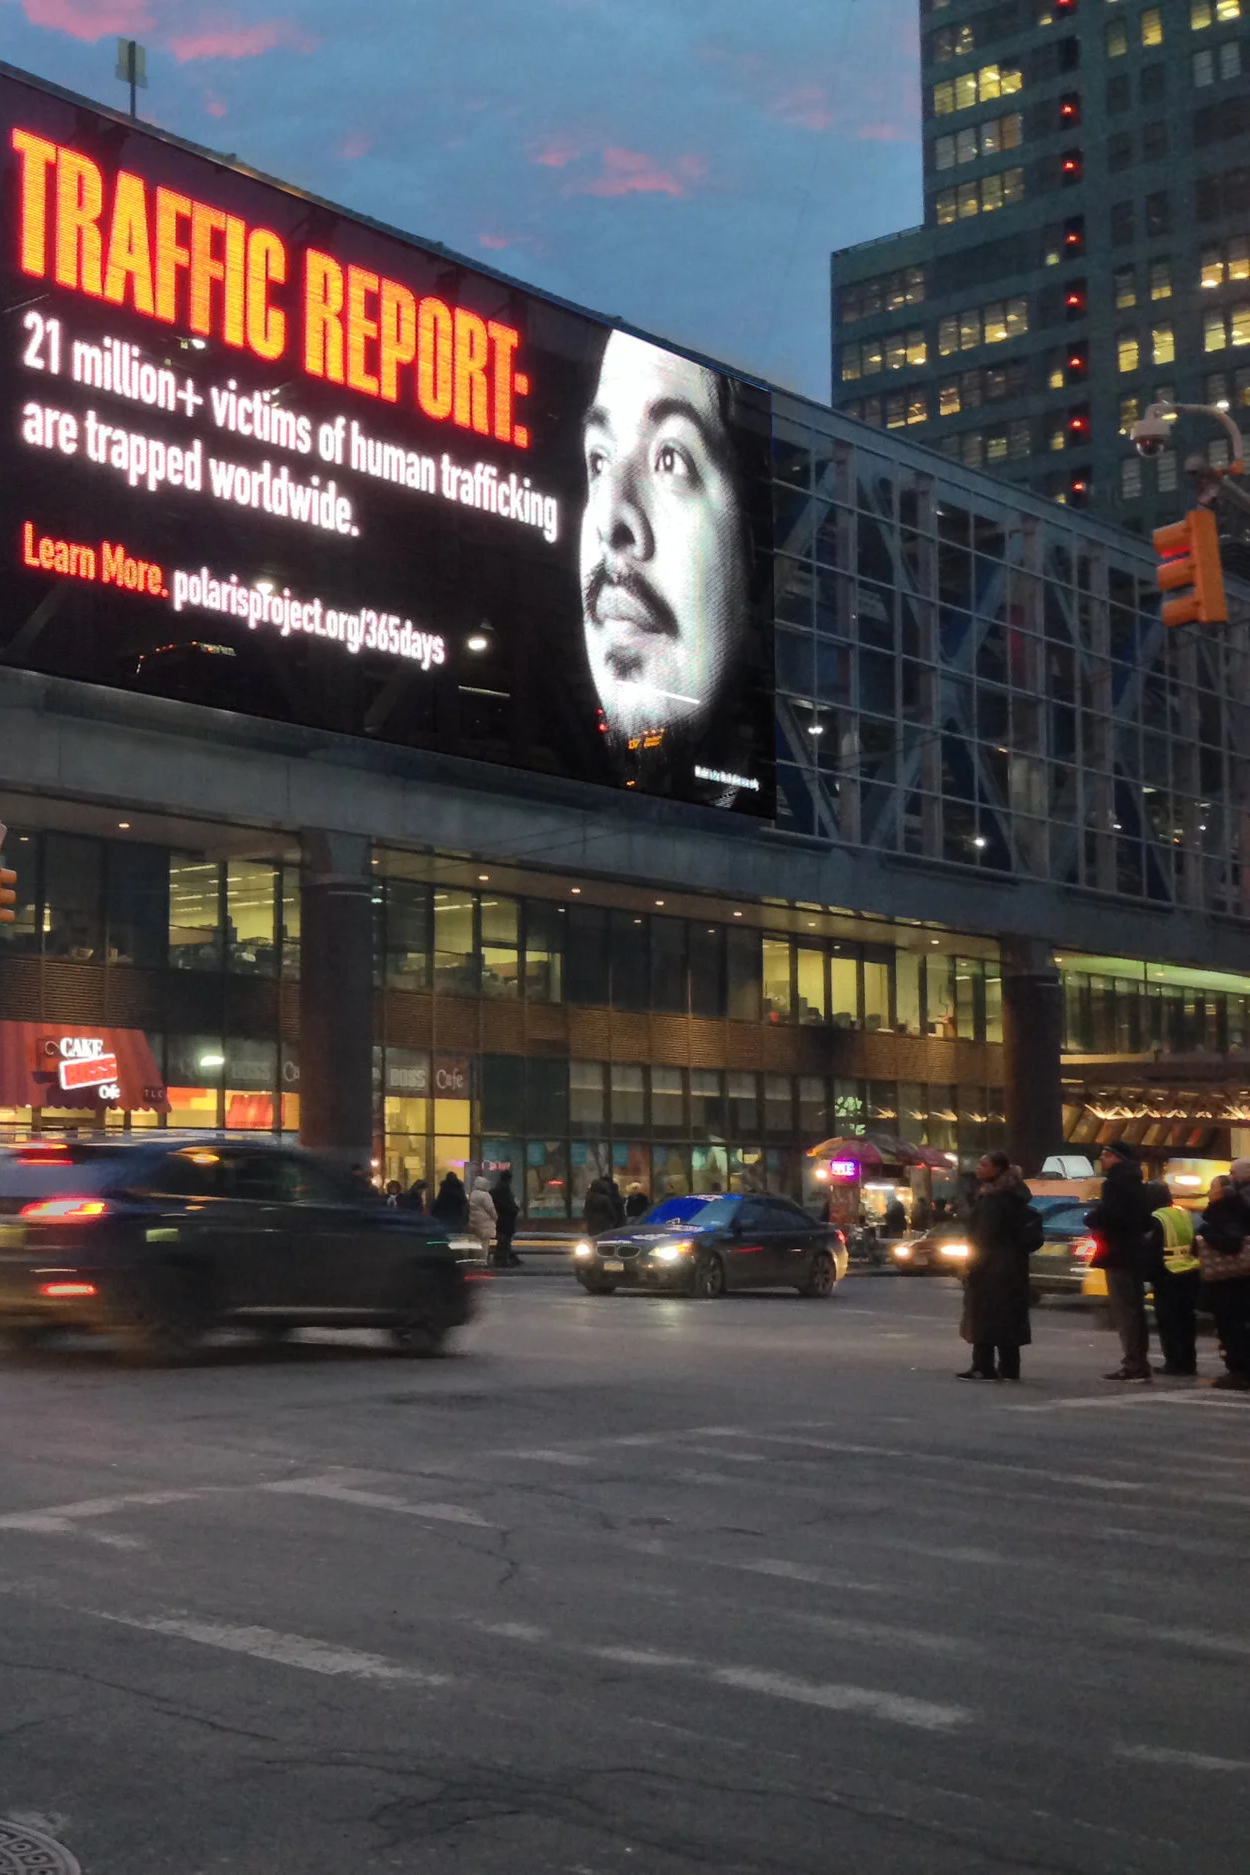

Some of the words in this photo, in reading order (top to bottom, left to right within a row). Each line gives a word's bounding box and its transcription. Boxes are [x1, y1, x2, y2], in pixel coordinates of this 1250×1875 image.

[11, 127, 287, 362] TRAFFIC
[304, 247, 530, 449] REPORT:
[23, 310, 62, 375] 21
[72, 335, 203, 417] million+
[209, 378, 312, 454] victims
[318, 416, 347, 465] of
[350, 420, 436, 494] human
[441, 452, 559, 544] trafficking
[23, 402, 78, 454] are
[84, 410, 203, 492] trapped
[208, 459, 360, 537] worldwide.
[23, 521, 96, 580] Learn
[100, 540, 170, 598] More.
[173, 567, 446, 670] polarisproject.org/365days
[60, 1037, 105, 1058] CAKE
[144, 1088, 164, 1099] TLC
[436, 1067, 463, 1091] Cafe
